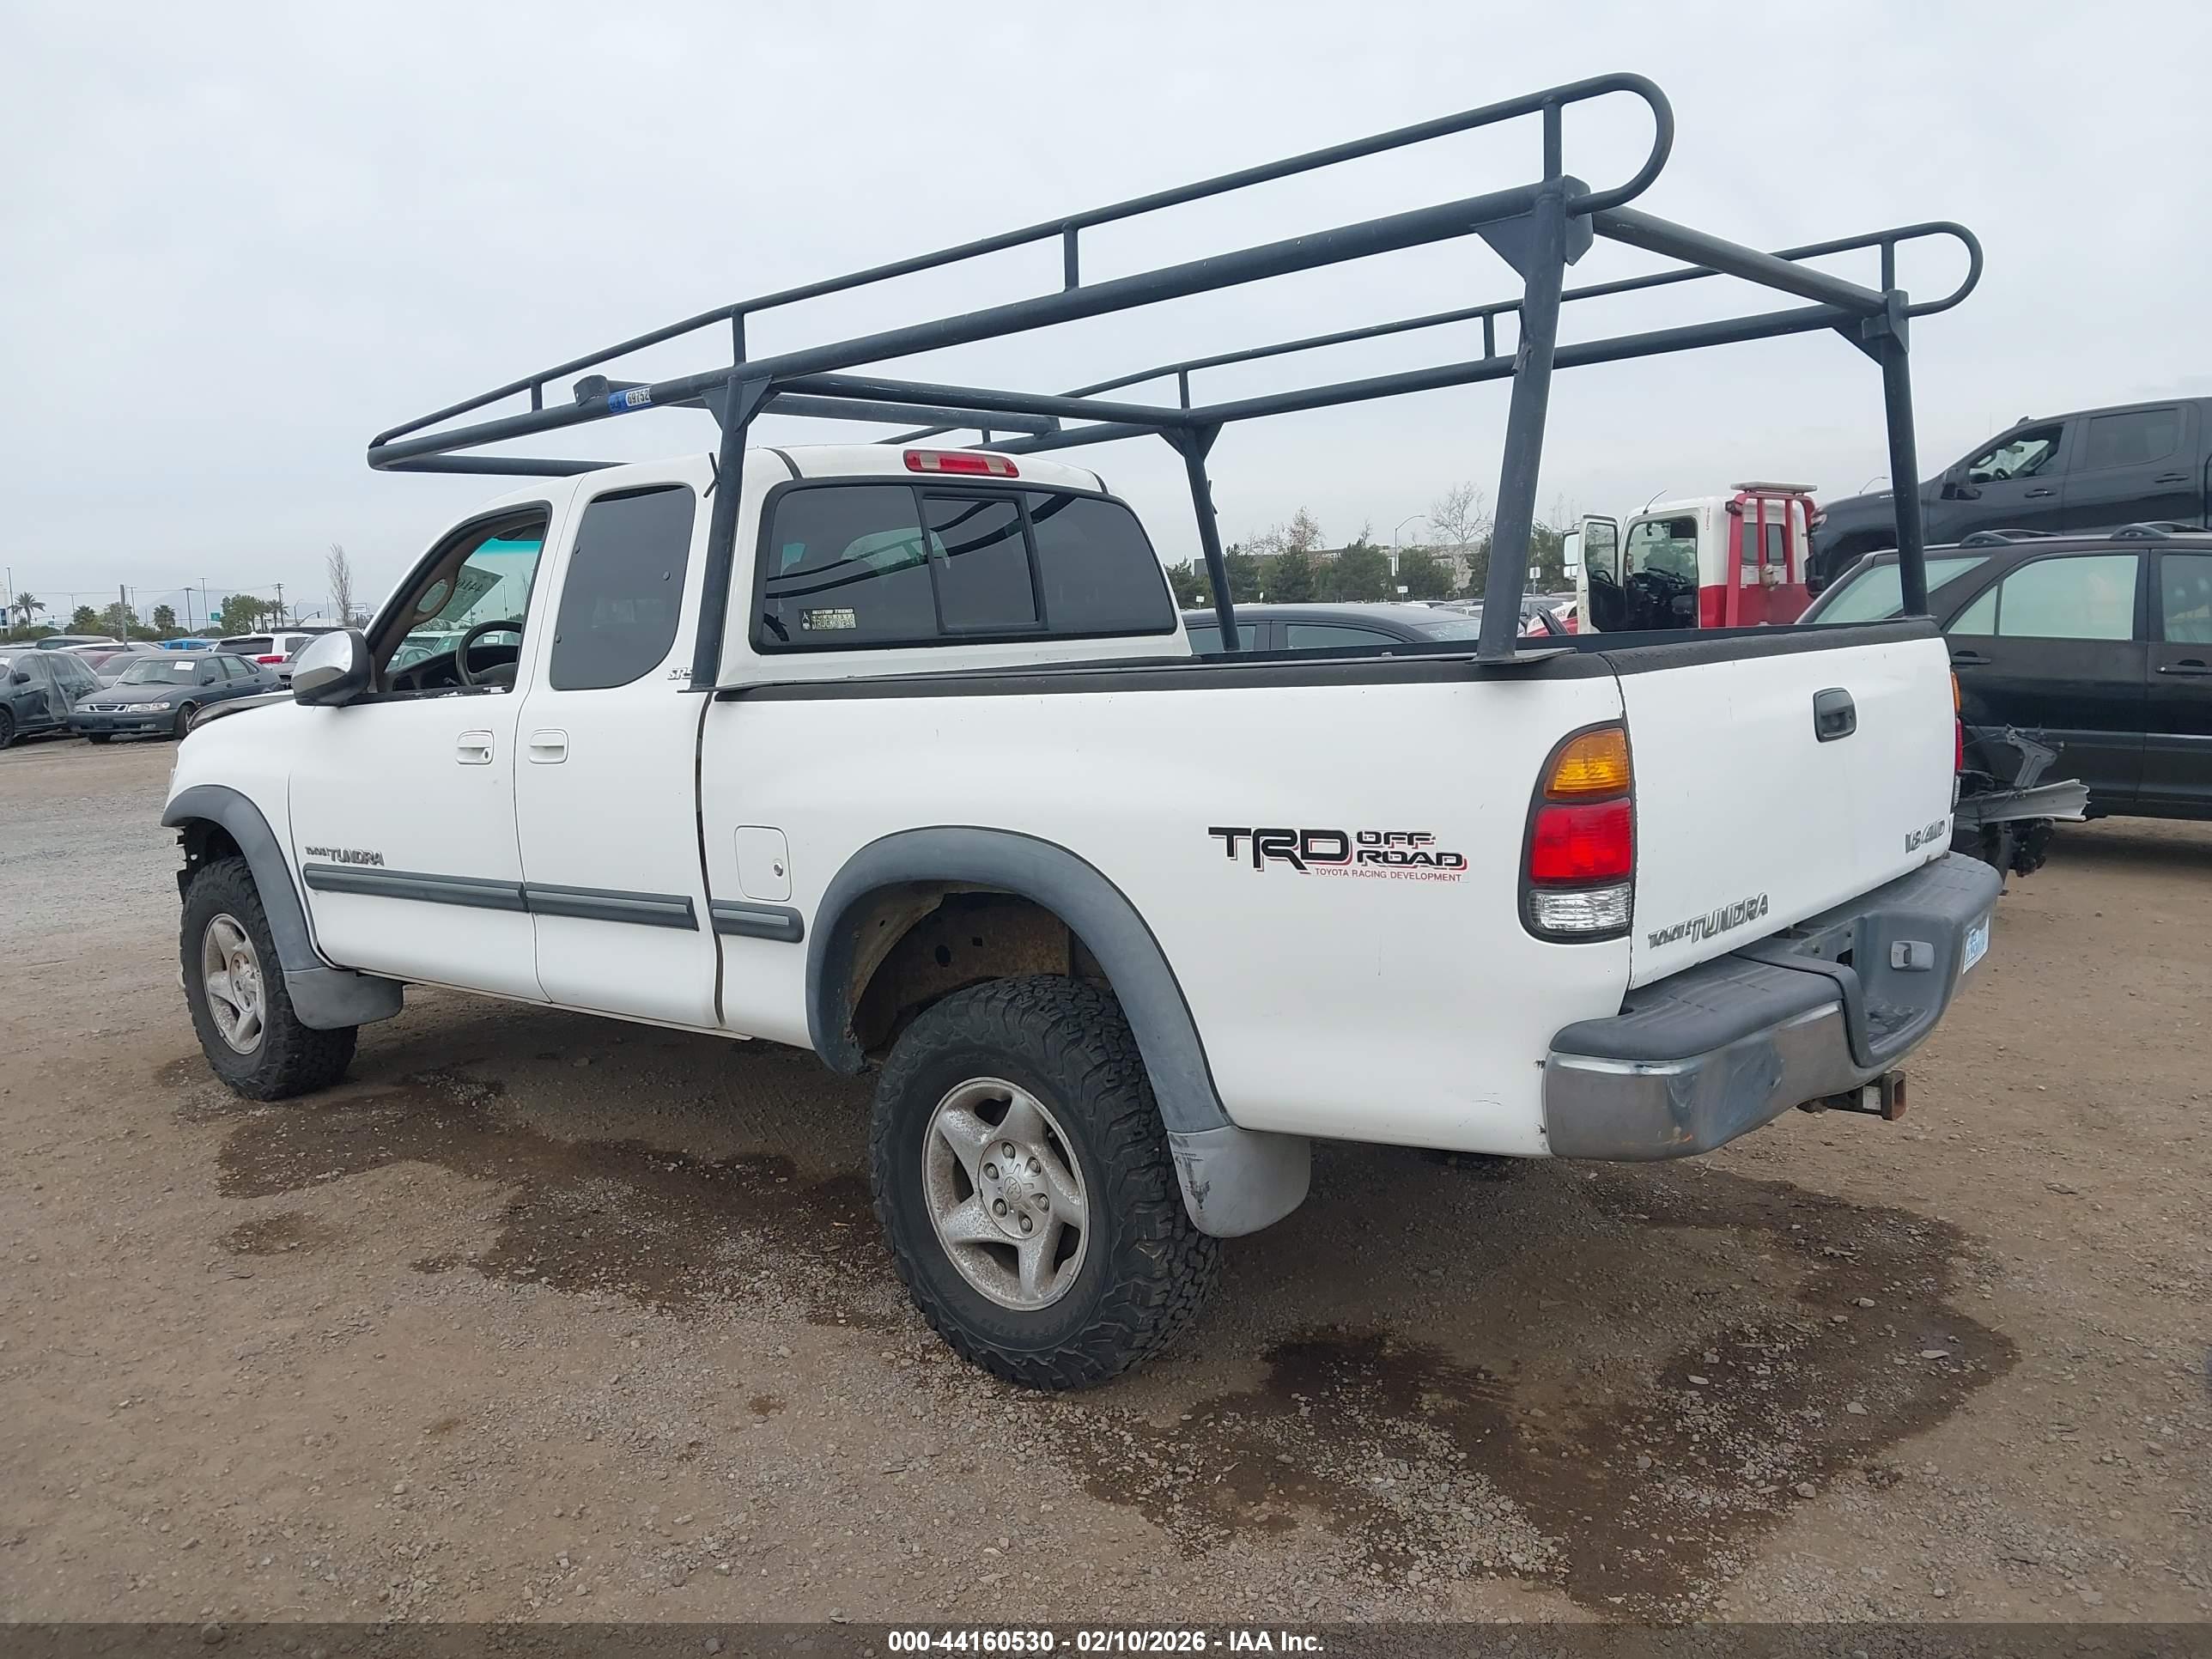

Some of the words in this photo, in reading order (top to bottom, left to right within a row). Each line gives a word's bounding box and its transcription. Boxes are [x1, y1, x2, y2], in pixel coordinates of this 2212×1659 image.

[1357, 830, 1436, 849] OFF
[327, 848, 385, 866] TUNDRA
[1208, 826, 1353, 874] TRD
[1357, 849, 1468, 871] ROAD
[1316, 867, 1349, 877] TOYOTA
[1352, 869, 1387, 878] RACING
[1390, 871, 1462, 882] DEVELOPMENT
[1689, 892, 1769, 944] TUNDRA
